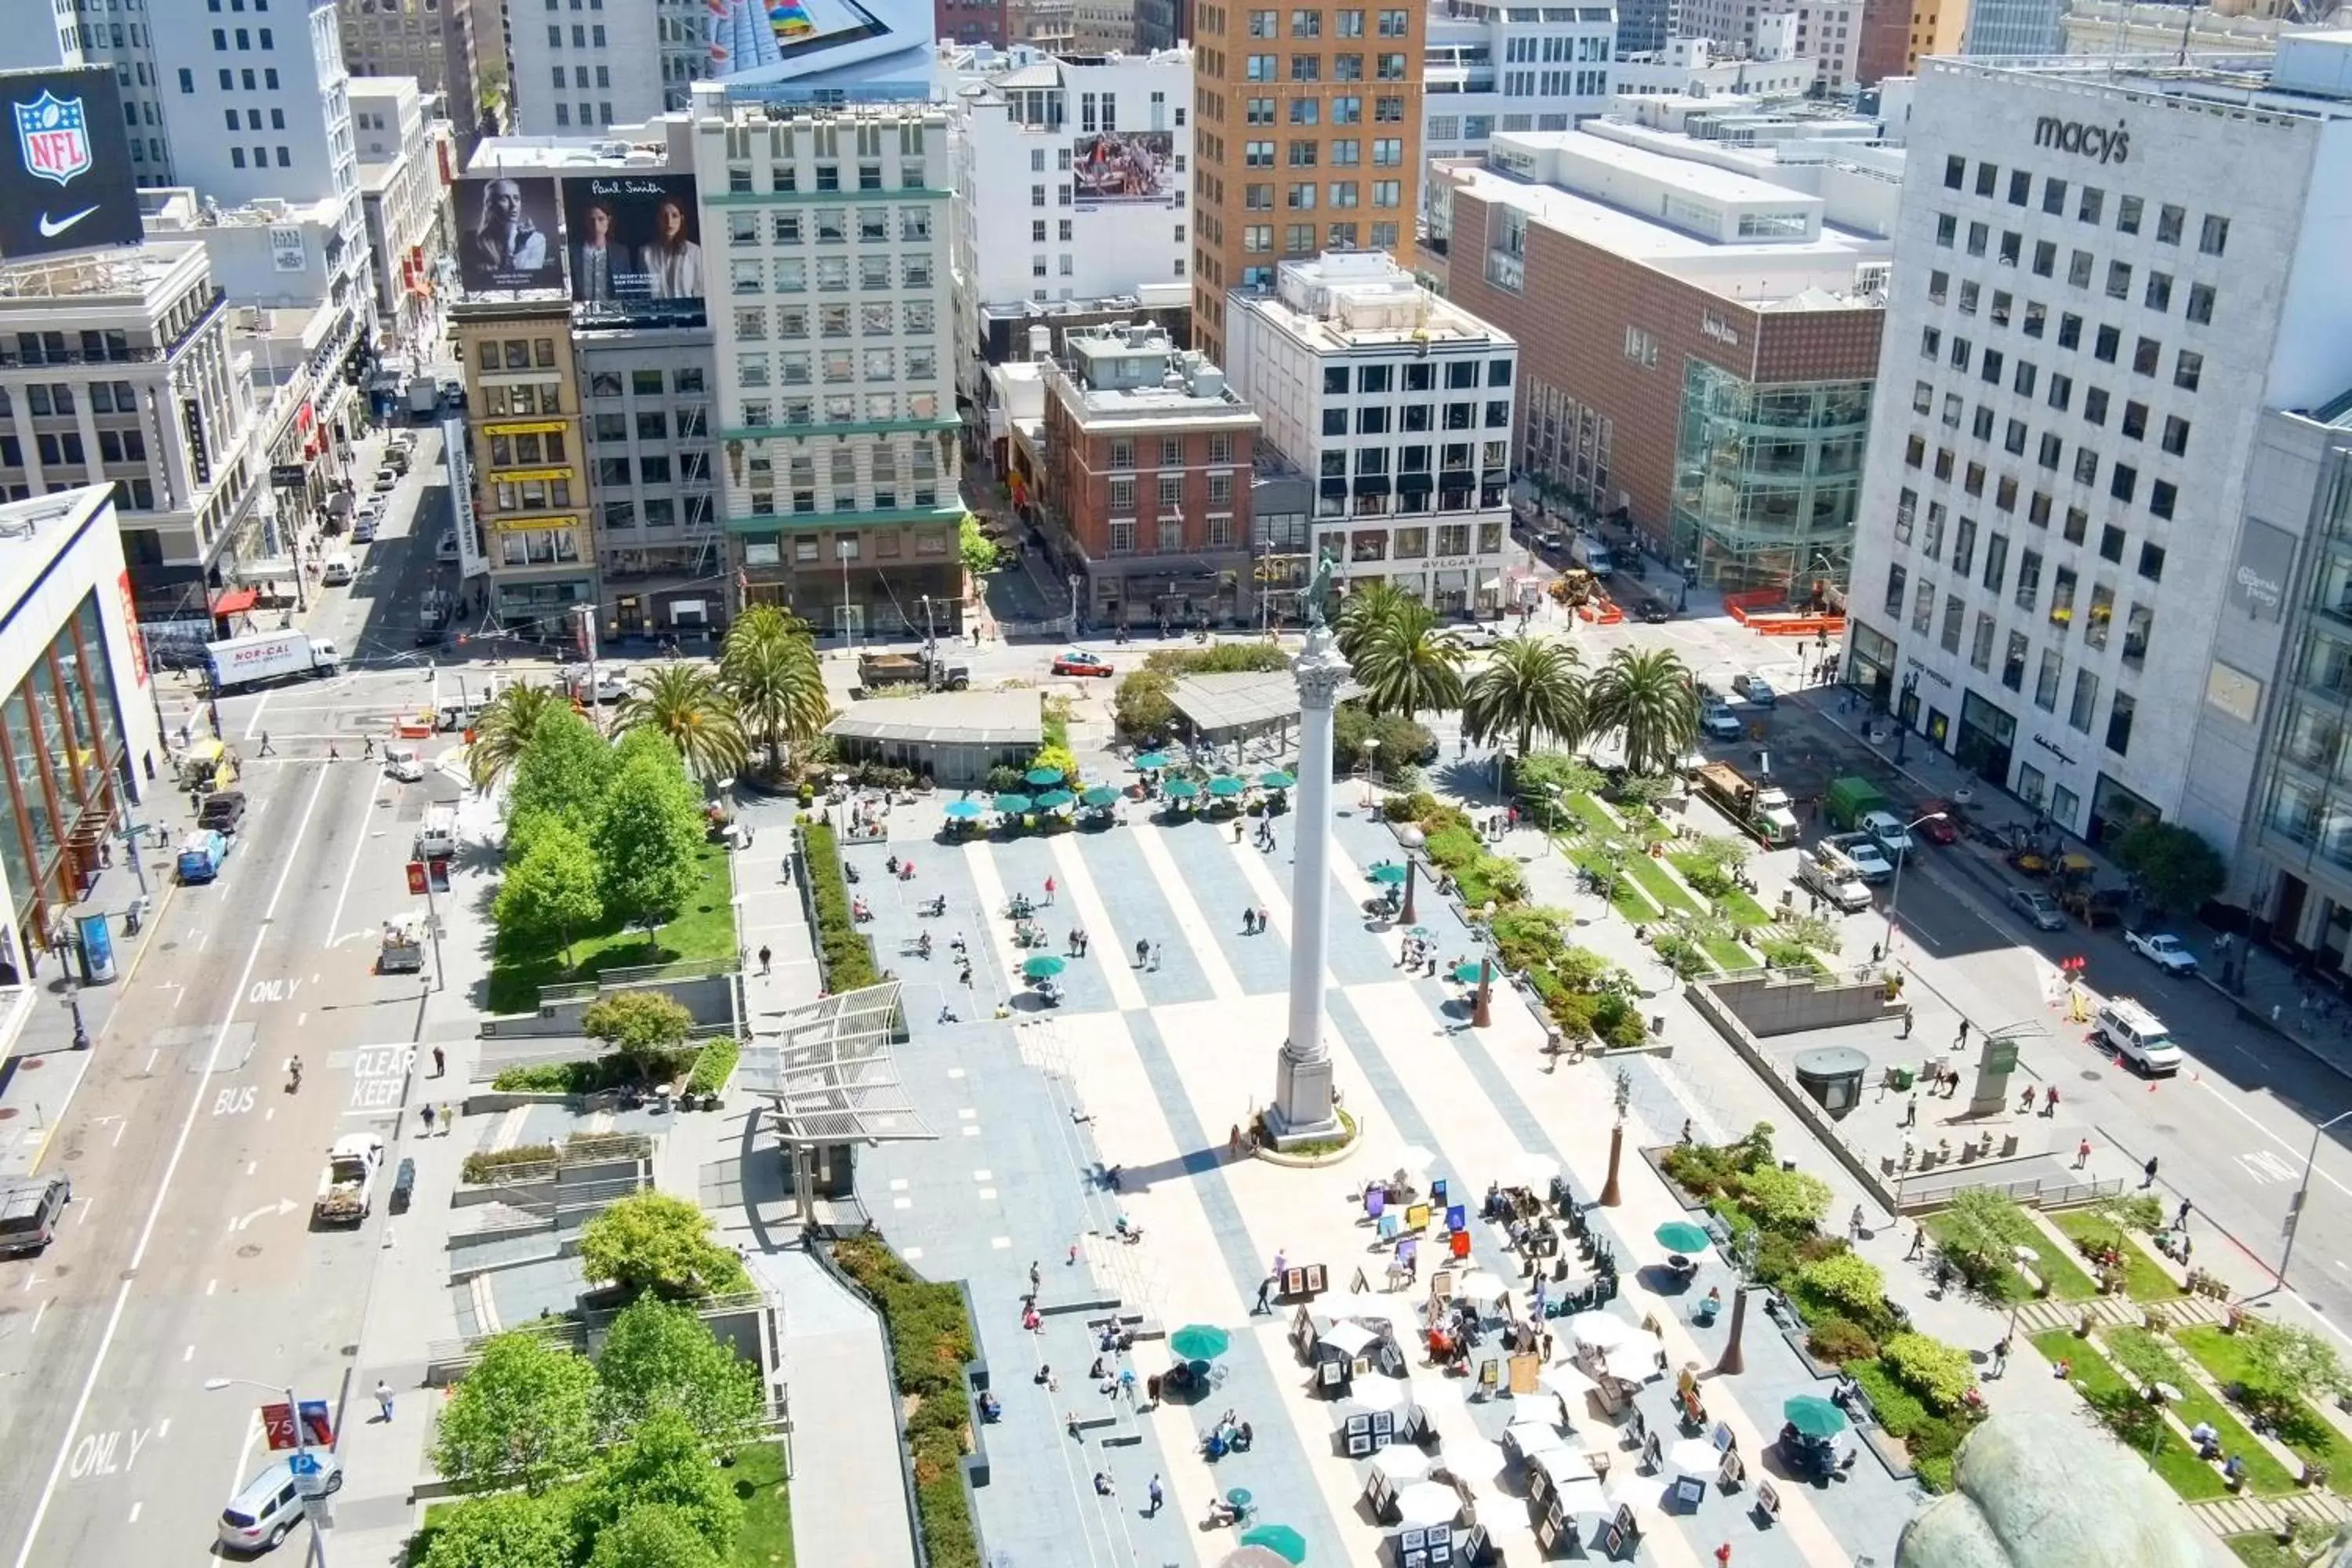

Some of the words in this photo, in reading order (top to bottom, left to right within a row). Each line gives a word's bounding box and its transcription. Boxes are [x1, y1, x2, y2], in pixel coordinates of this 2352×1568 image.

[29, 132, 84, 172] NFL
[2034, 115, 2131, 165] macy's
[592, 180, 621, 195] Paul
[625, 180, 666, 194] Smith
[234, 644, 290, 661] NOR-CAL
[249, 978, 303, 1003] ONLY
[354, 1050, 416, 1076] CLEAR
[212, 1086, 260, 1116] BUS
[350, 1079, 403, 1106] KEEP
[267, 1421, 294, 1437] 75
[70, 1428, 151, 1479] ONLY
[295, 1457, 311, 1472] P
